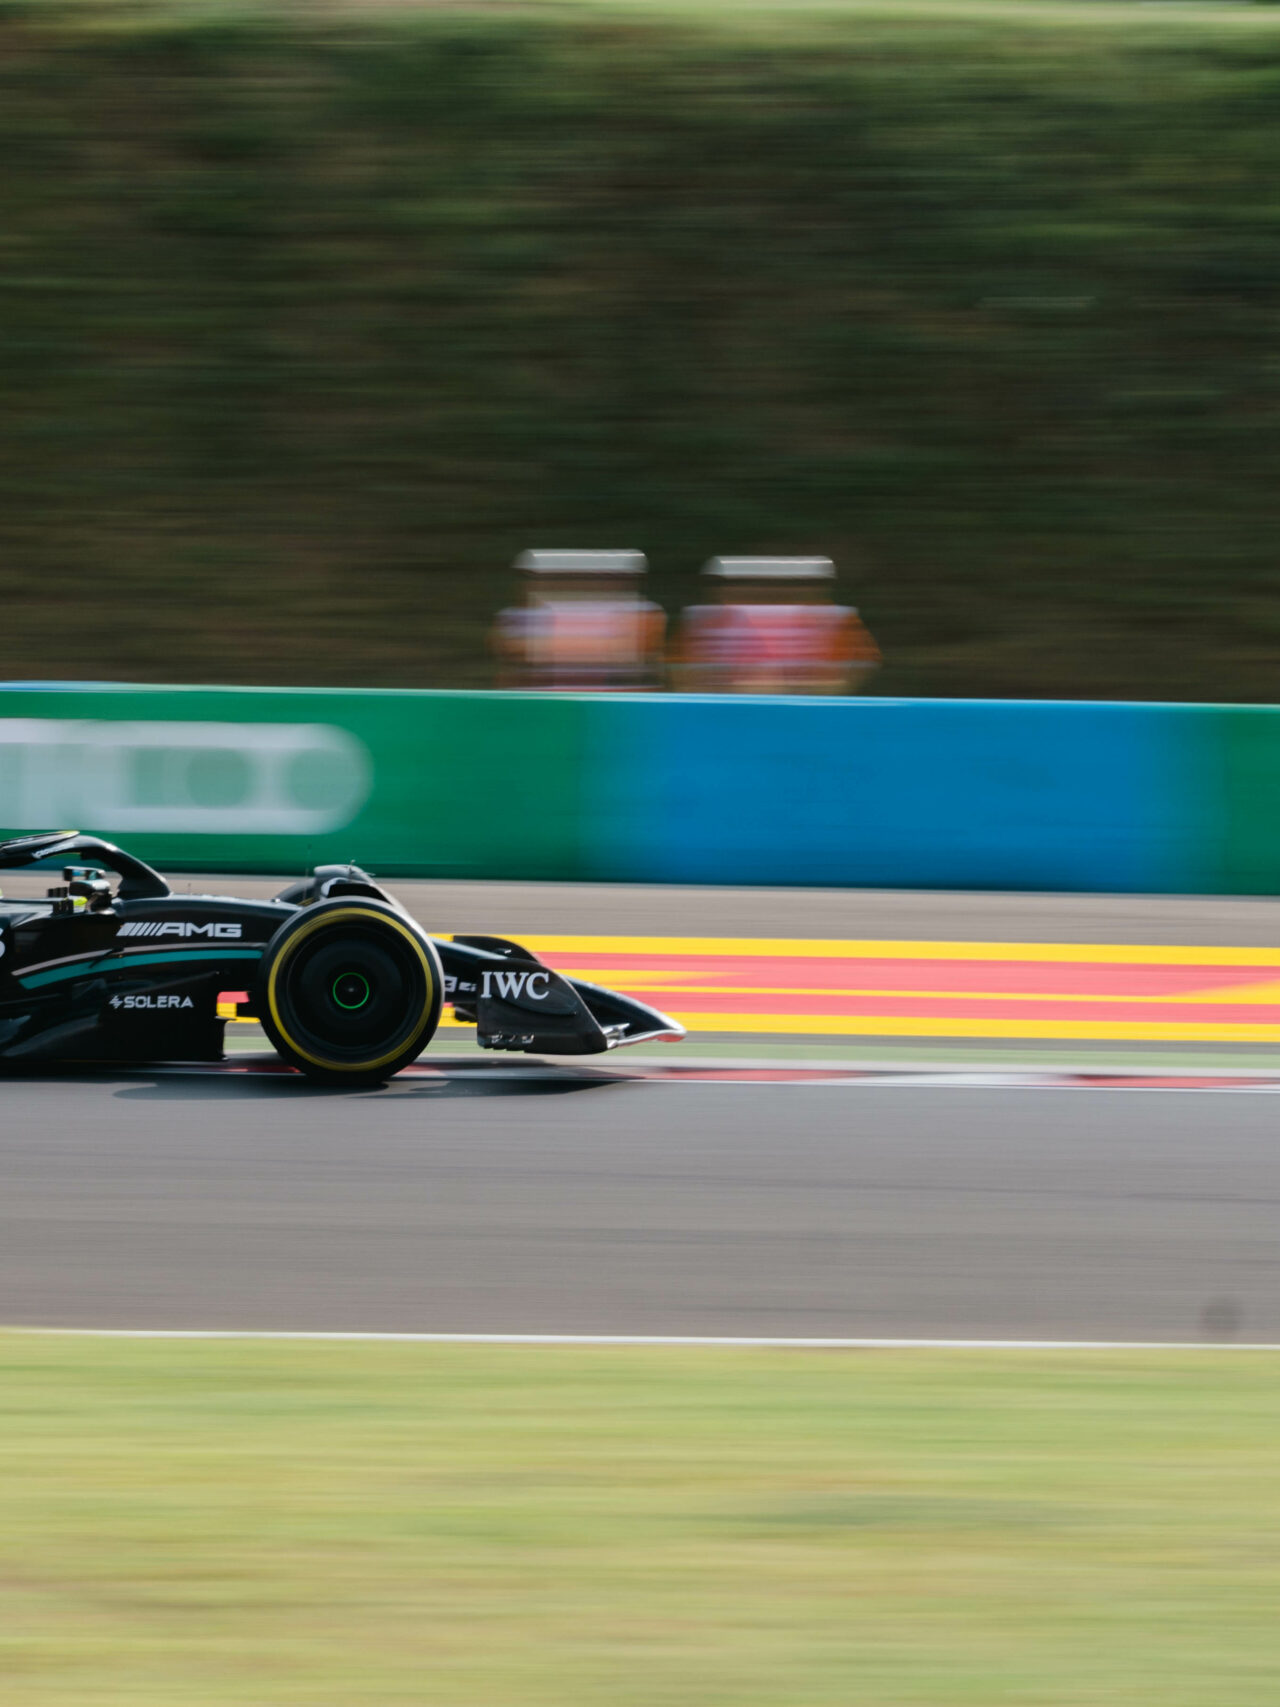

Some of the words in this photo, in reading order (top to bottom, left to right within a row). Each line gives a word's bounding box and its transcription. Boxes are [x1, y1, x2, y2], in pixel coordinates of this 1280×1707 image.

[155, 922, 242, 938] AMG
[480, 971, 550, 1000] IWC
[123, 995, 194, 1009] SOLERA
